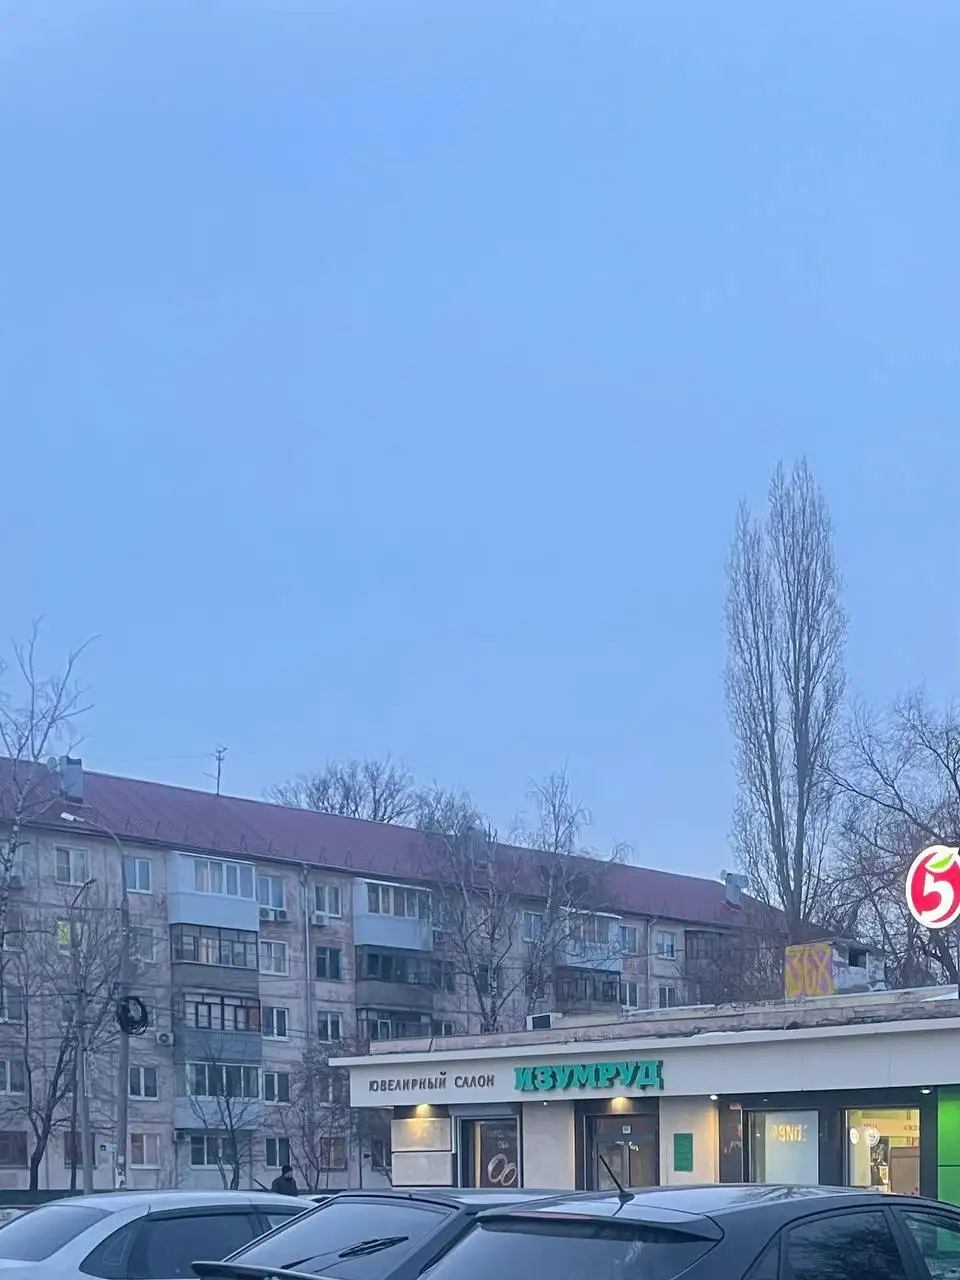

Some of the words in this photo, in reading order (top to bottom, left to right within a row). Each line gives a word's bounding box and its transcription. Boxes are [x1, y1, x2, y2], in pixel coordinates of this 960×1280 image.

[368, 1071, 447, 1093] ЮВЕЛИРНЫЙ
[454, 1074, 495, 1089] САЛОН
[514, 1060, 665, 1092] ИЗУМРУД
